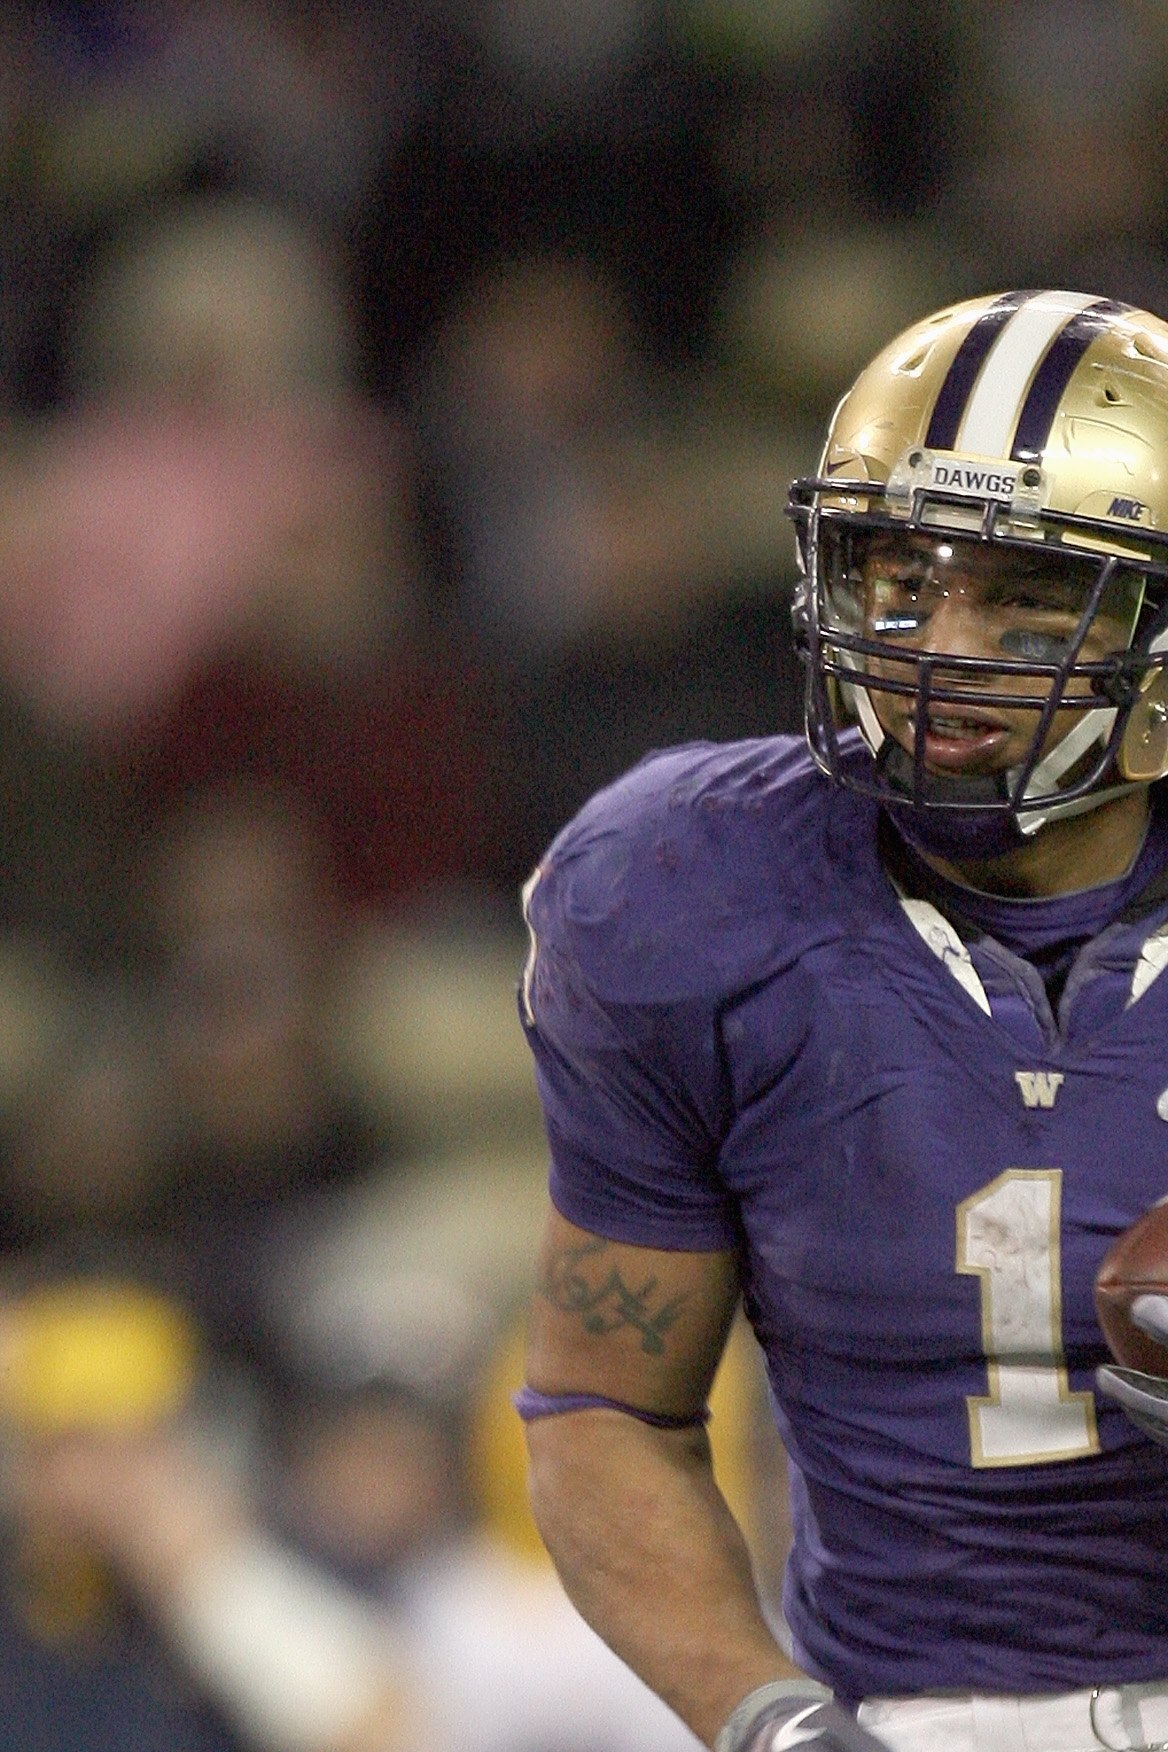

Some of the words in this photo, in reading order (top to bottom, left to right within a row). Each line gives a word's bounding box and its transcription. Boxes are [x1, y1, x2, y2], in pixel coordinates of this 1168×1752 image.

[934, 467, 1016, 494] DAWGS
[1014, 1071, 1065, 1108] W
[955, 1168, 1100, 1468] 1
